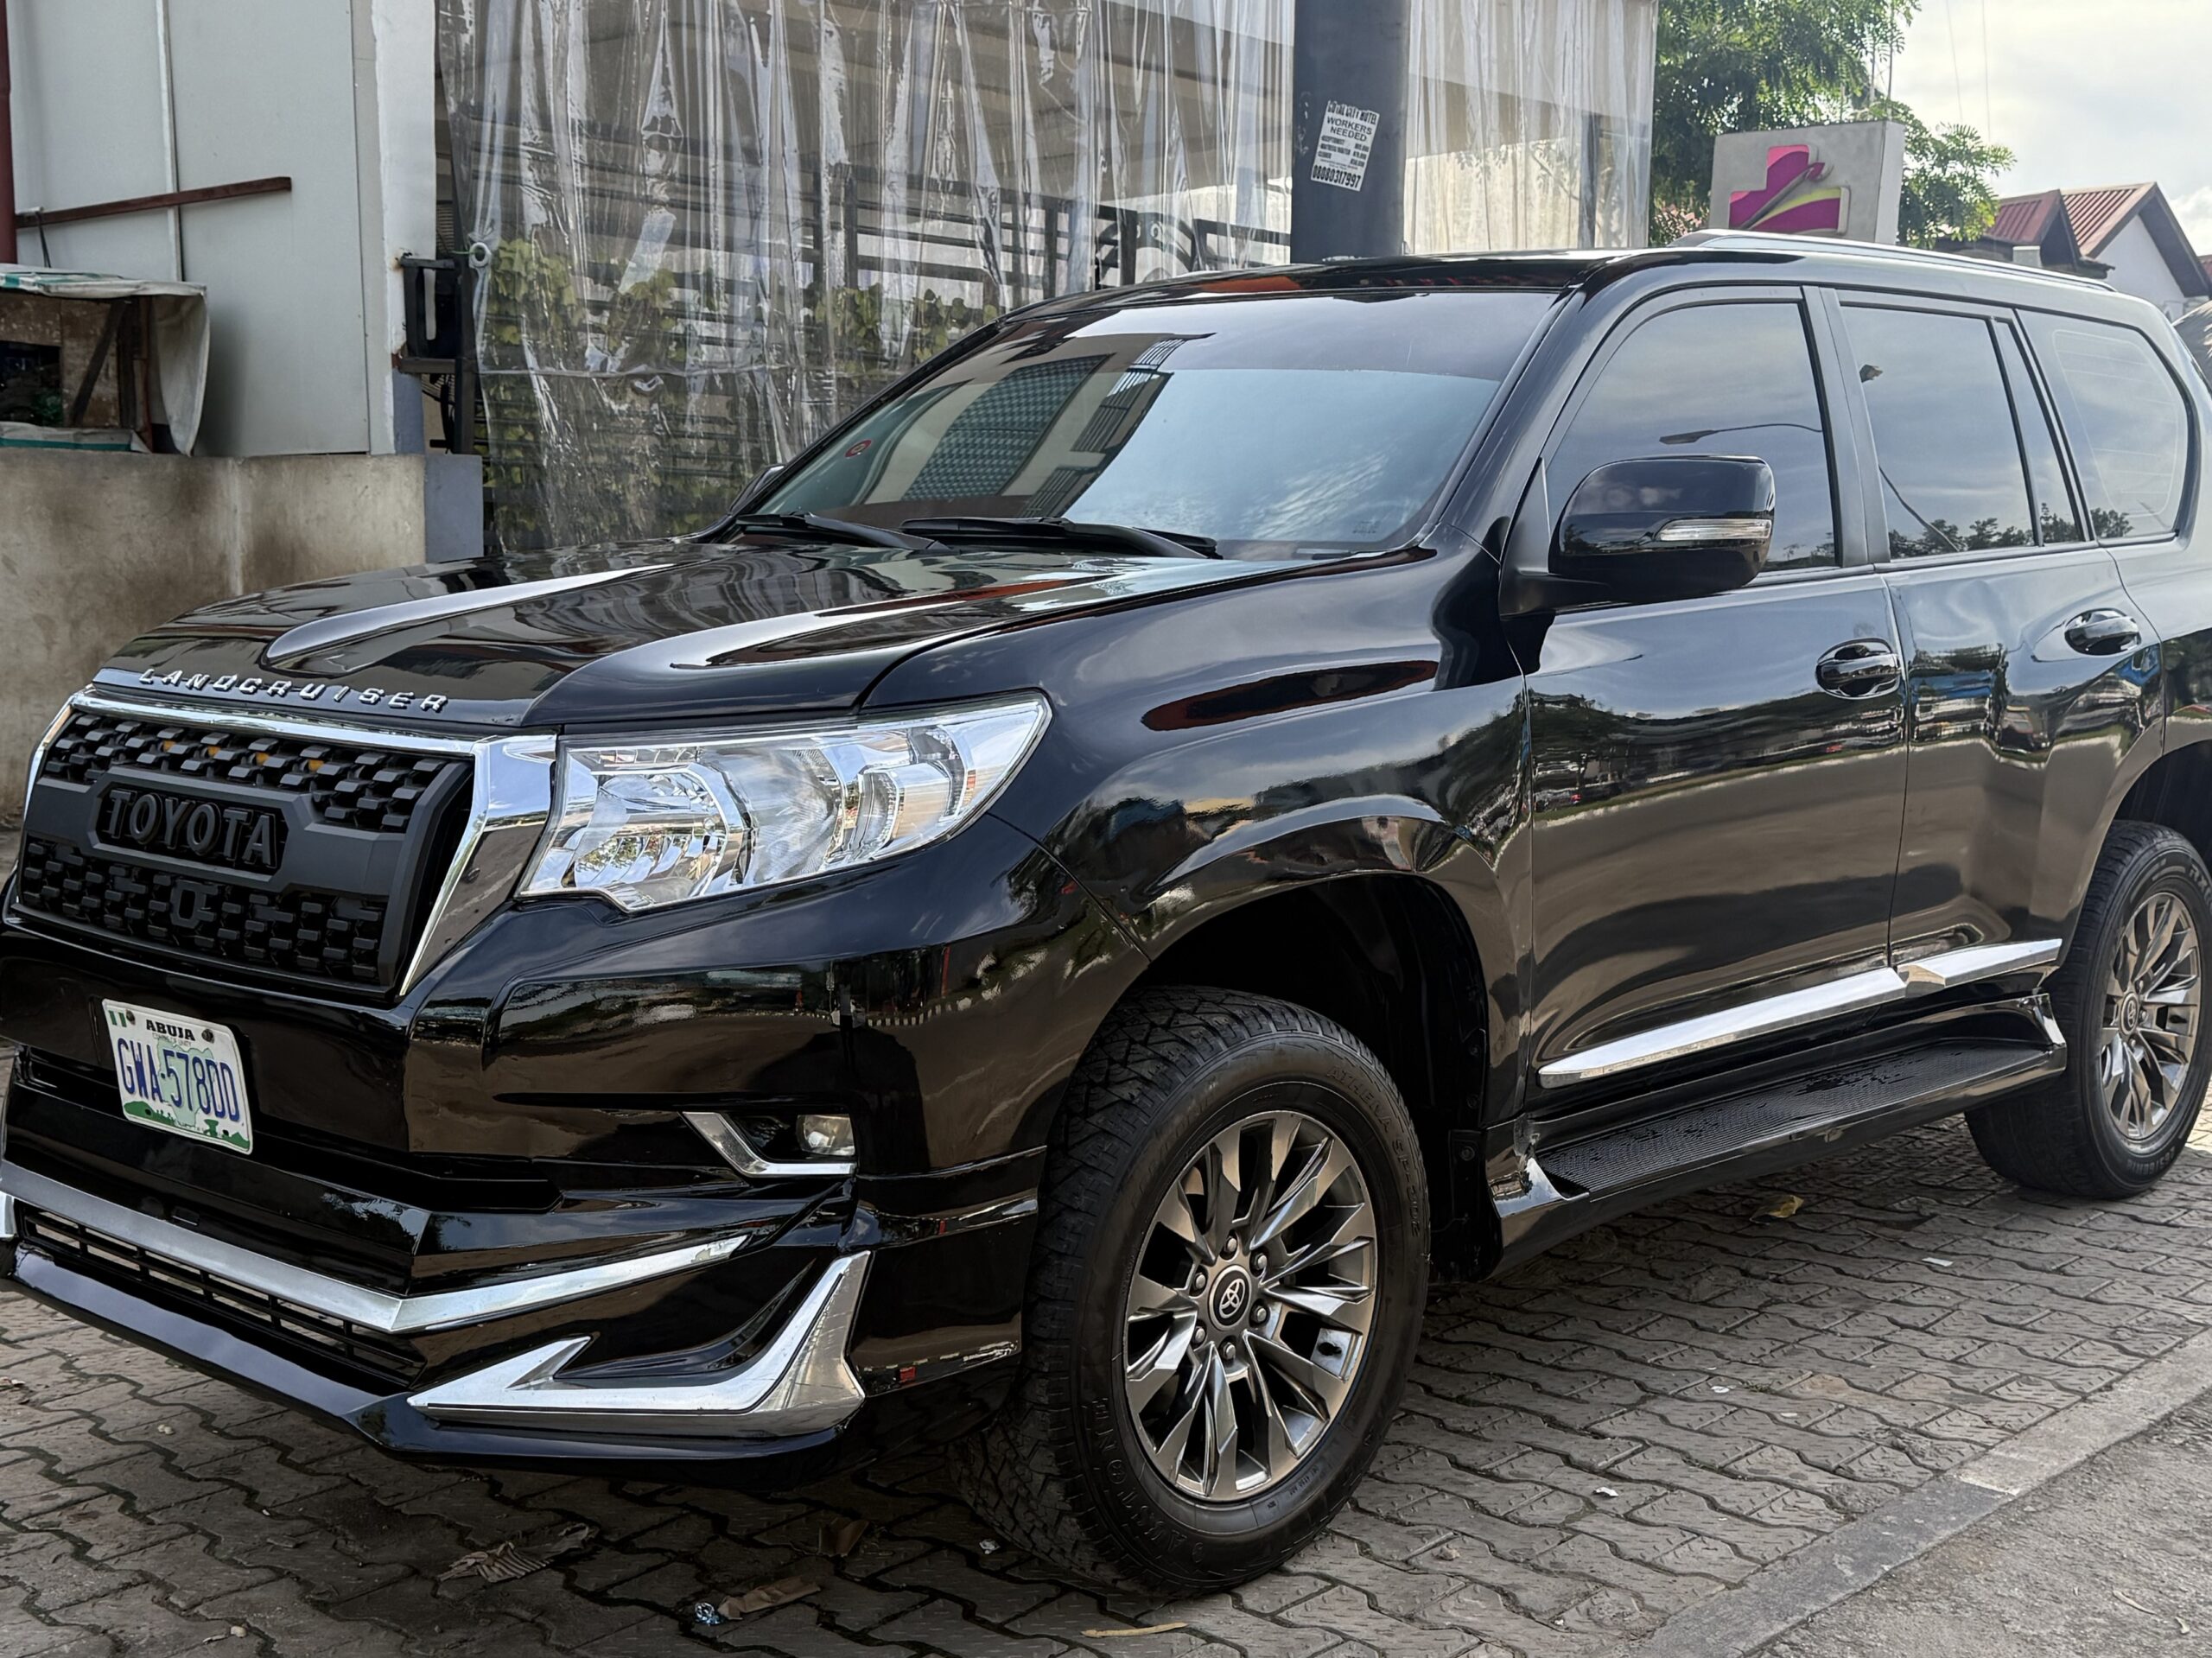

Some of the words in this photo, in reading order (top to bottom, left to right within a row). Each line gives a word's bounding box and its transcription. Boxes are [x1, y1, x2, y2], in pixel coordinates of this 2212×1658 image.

[1327, 116, 1372, 135] WORKERS
[1331, 126, 1367, 142] NEEDED
[107, 788, 277, 869] TOYOTA
[145, 1019, 196, 1041] ABUJA
[1325, 1064, 1393, 1134] ATHENA
